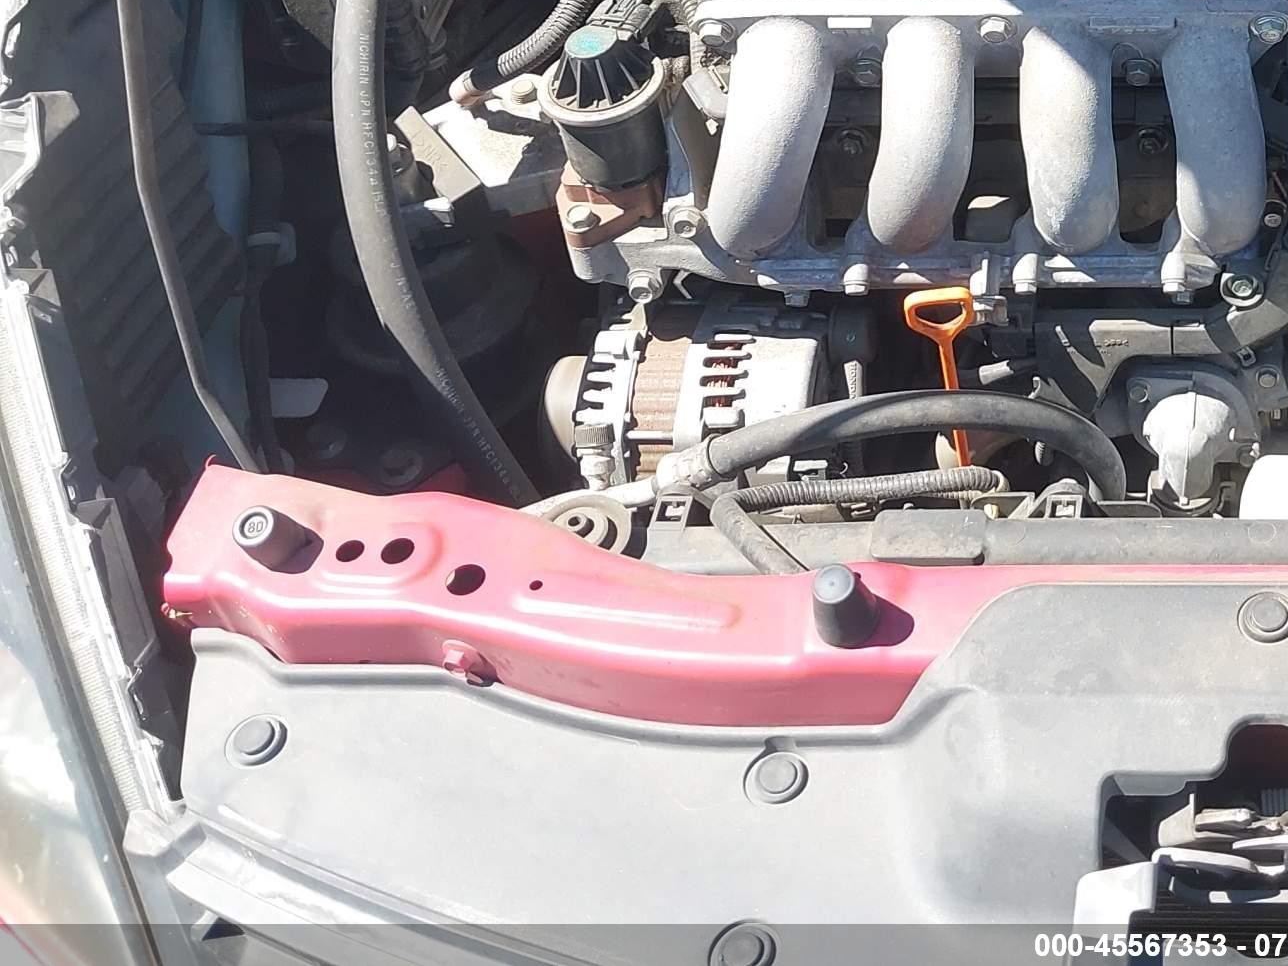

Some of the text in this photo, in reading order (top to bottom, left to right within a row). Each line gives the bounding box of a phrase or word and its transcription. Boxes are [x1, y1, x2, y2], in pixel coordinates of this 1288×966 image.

[358, 33, 371, 85] NICHIRIN
[360, 90, 373, 117] JPN
[849, 362, 858, 400] HONDA
